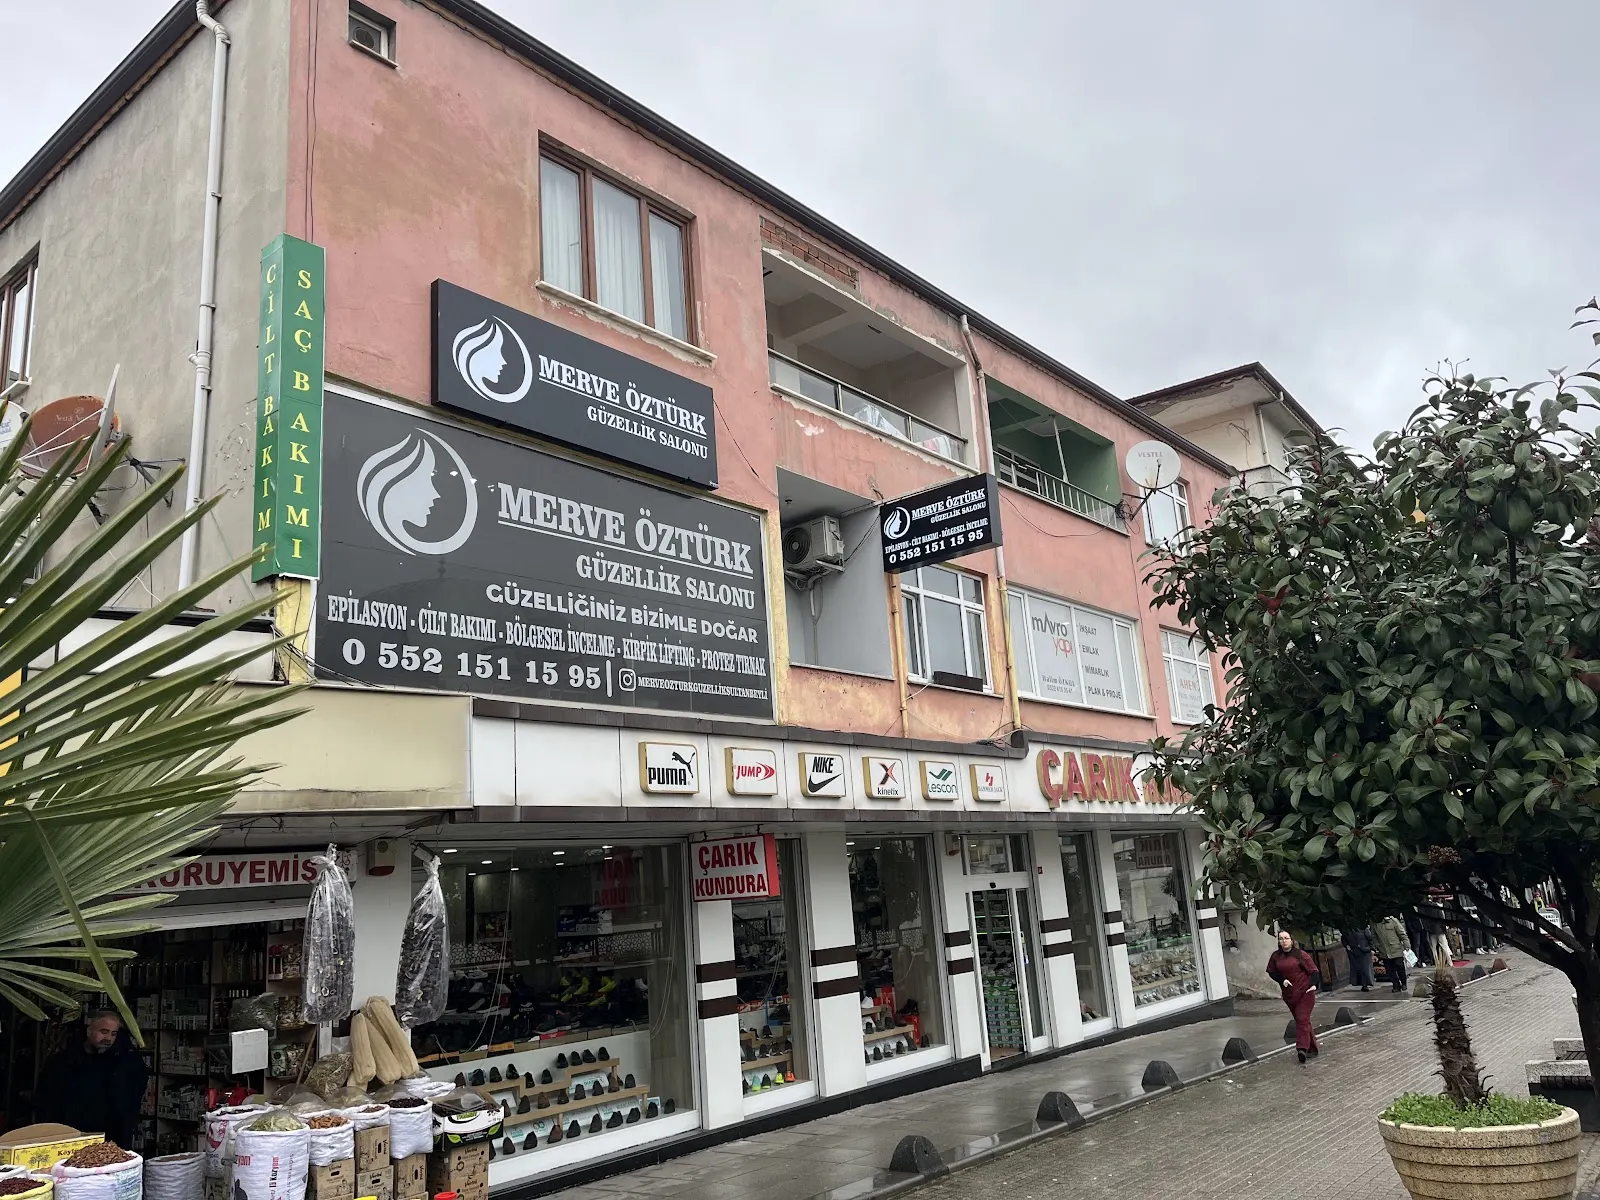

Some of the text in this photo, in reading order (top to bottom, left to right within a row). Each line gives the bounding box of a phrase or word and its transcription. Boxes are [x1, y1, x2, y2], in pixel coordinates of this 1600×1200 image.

[258, 263, 277, 563] CİLT BAKIMI
[538, 354, 707, 436] MERVE ÖZTÜRK
[285, 269, 313, 559] SAÇ BAKIMI
[587, 405, 708, 459] GÜZELLİK SALONU
[911, 487, 986, 519] MERVE ÖZTÜRK
[930, 501, 987, 524] GÜZELLİK SALONU
[497, 482, 754, 575] MERVE ÖZTÜRK
[884, 517, 989, 555] EPİLASYON CİLT BAKIMI BÖLGESEL İNCELME
[888, 528, 984, 564] 0 552 151 15 95
[576, 550, 755, 610] GÜZELLİK SALONU
[485, 581, 759, 644] GÜZELLİĞİNİZ BİZİMLE DOĞAR
[327, 589, 408, 631] EPİLASYON
[418, 601, 448, 636] CİLT
[450, 613, 497, 643] BAKIMI
[505, 615, 566, 652] BÖLGESEL
[567, 623, 616, 658] İNCELME
[622, 631, 658, 663] KİRPİK
[659, 637, 695, 668] LİFTİNG
[701, 648, 736, 673] PROTEZ
[735, 654, 767, 677] TIRNAK
[1082, 644, 1100, 656] EMLAK
[342, 638, 602, 690] 0 552 151 15 95
[1088, 685, 1102, 696] PLAN
[1106, 688, 1122, 700] PROJE
[648, 767, 687, 786] PUMA
[736, 764, 762, 780] JUMP
[812, 756, 835, 773] NIKE
[1036, 749, 1141, 809] ÇARIK
[877, 786, 899, 796] kinetix
[698, 841, 759, 875] ÇARIK
[695, 873, 767, 897] KUNDURA
